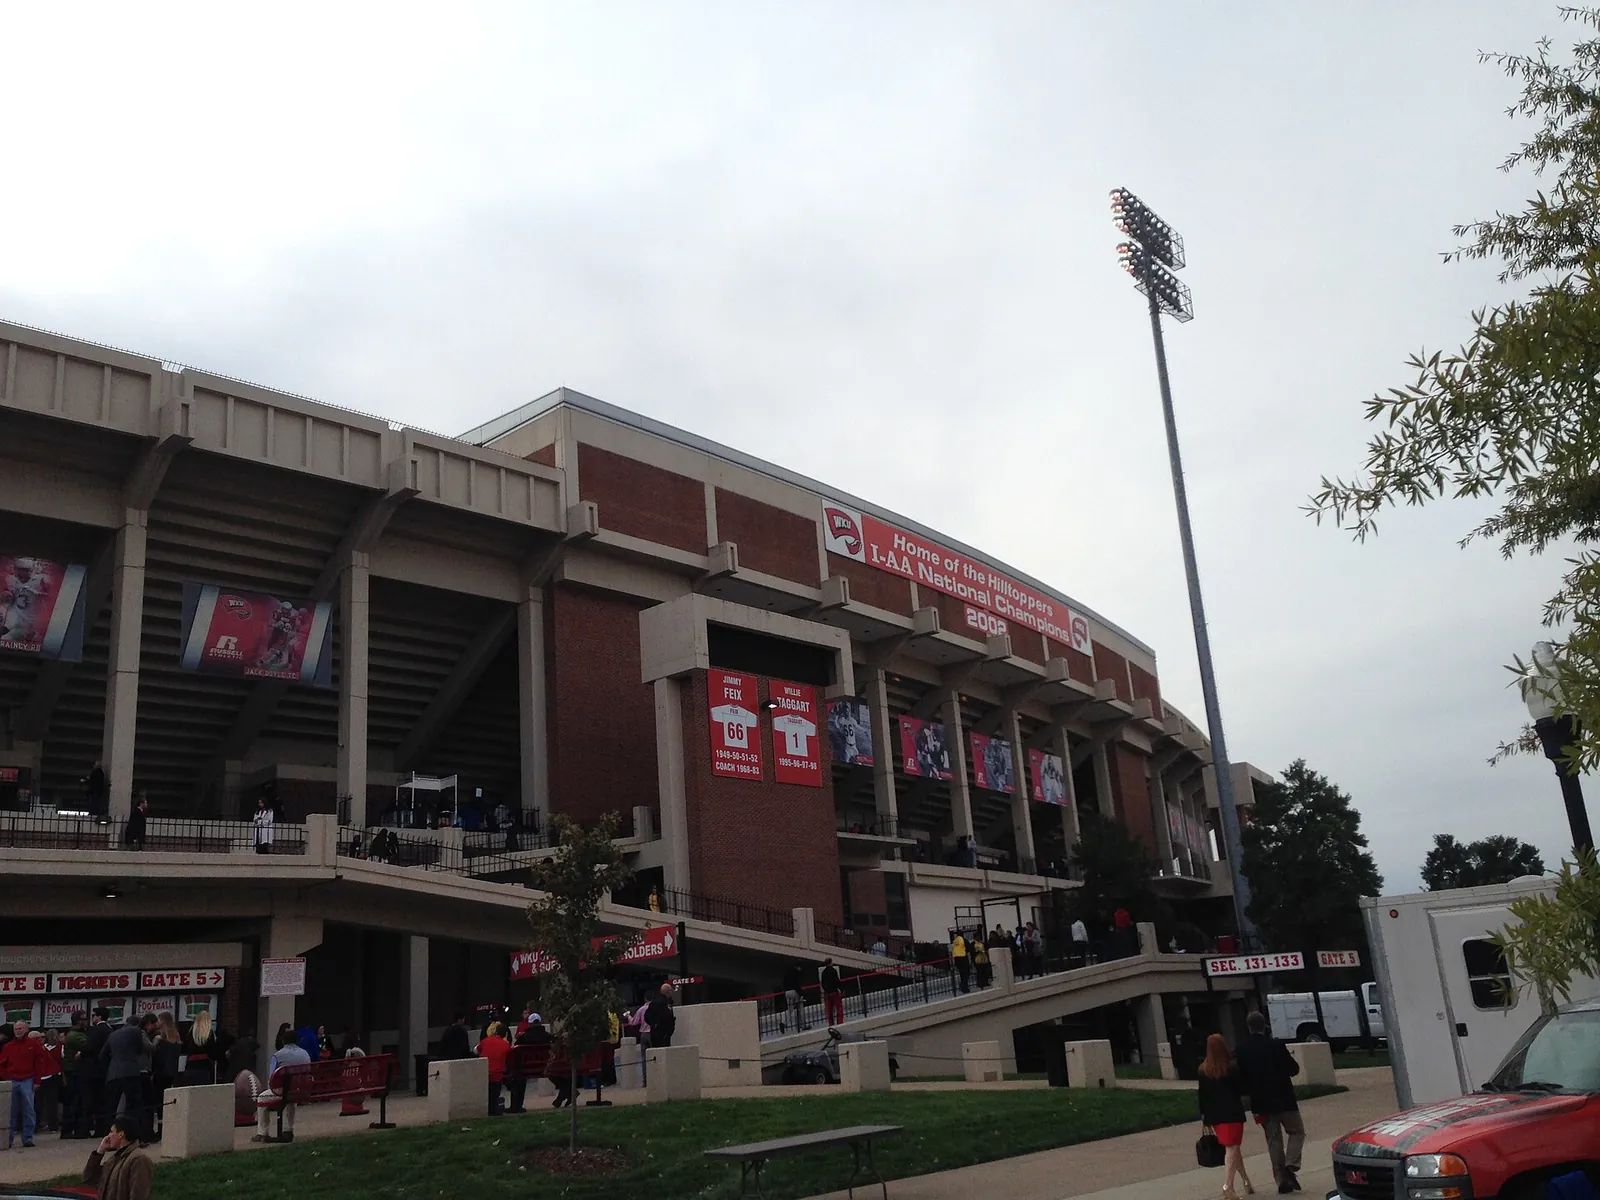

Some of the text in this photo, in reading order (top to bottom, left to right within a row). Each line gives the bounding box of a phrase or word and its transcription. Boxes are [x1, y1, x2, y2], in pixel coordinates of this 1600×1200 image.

[833, 515, 852, 530] WKU
[893, 533, 1054, 617] Home of the Hilltoppers
[870, 543, 1070, 642] I-AA National Champions
[722, 676, 742, 686] JIMMY
[724, 688, 742, 701] FEIX
[784, 686, 801, 697] WILLIE
[776, 697, 810, 713] TAGGART
[728, 722, 744, 740] 66
[793, 733, 799, 749] 1
[715, 762, 736, 772] COACH
[519, 952, 539, 964] WKU
[1210, 954, 1300, 972] SEC. 131-133
[1320, 953, 1356, 965] GATE 5
[531, 963, 537, 974] &
[0, 977, 45, 991] TE 6
[57, 975, 130, 989] TICKETS
[142, 972, 207, 987] GATE 5
[672, 977, 689, 985] GATE
[138, 999, 173, 1011] FOOTBALL
